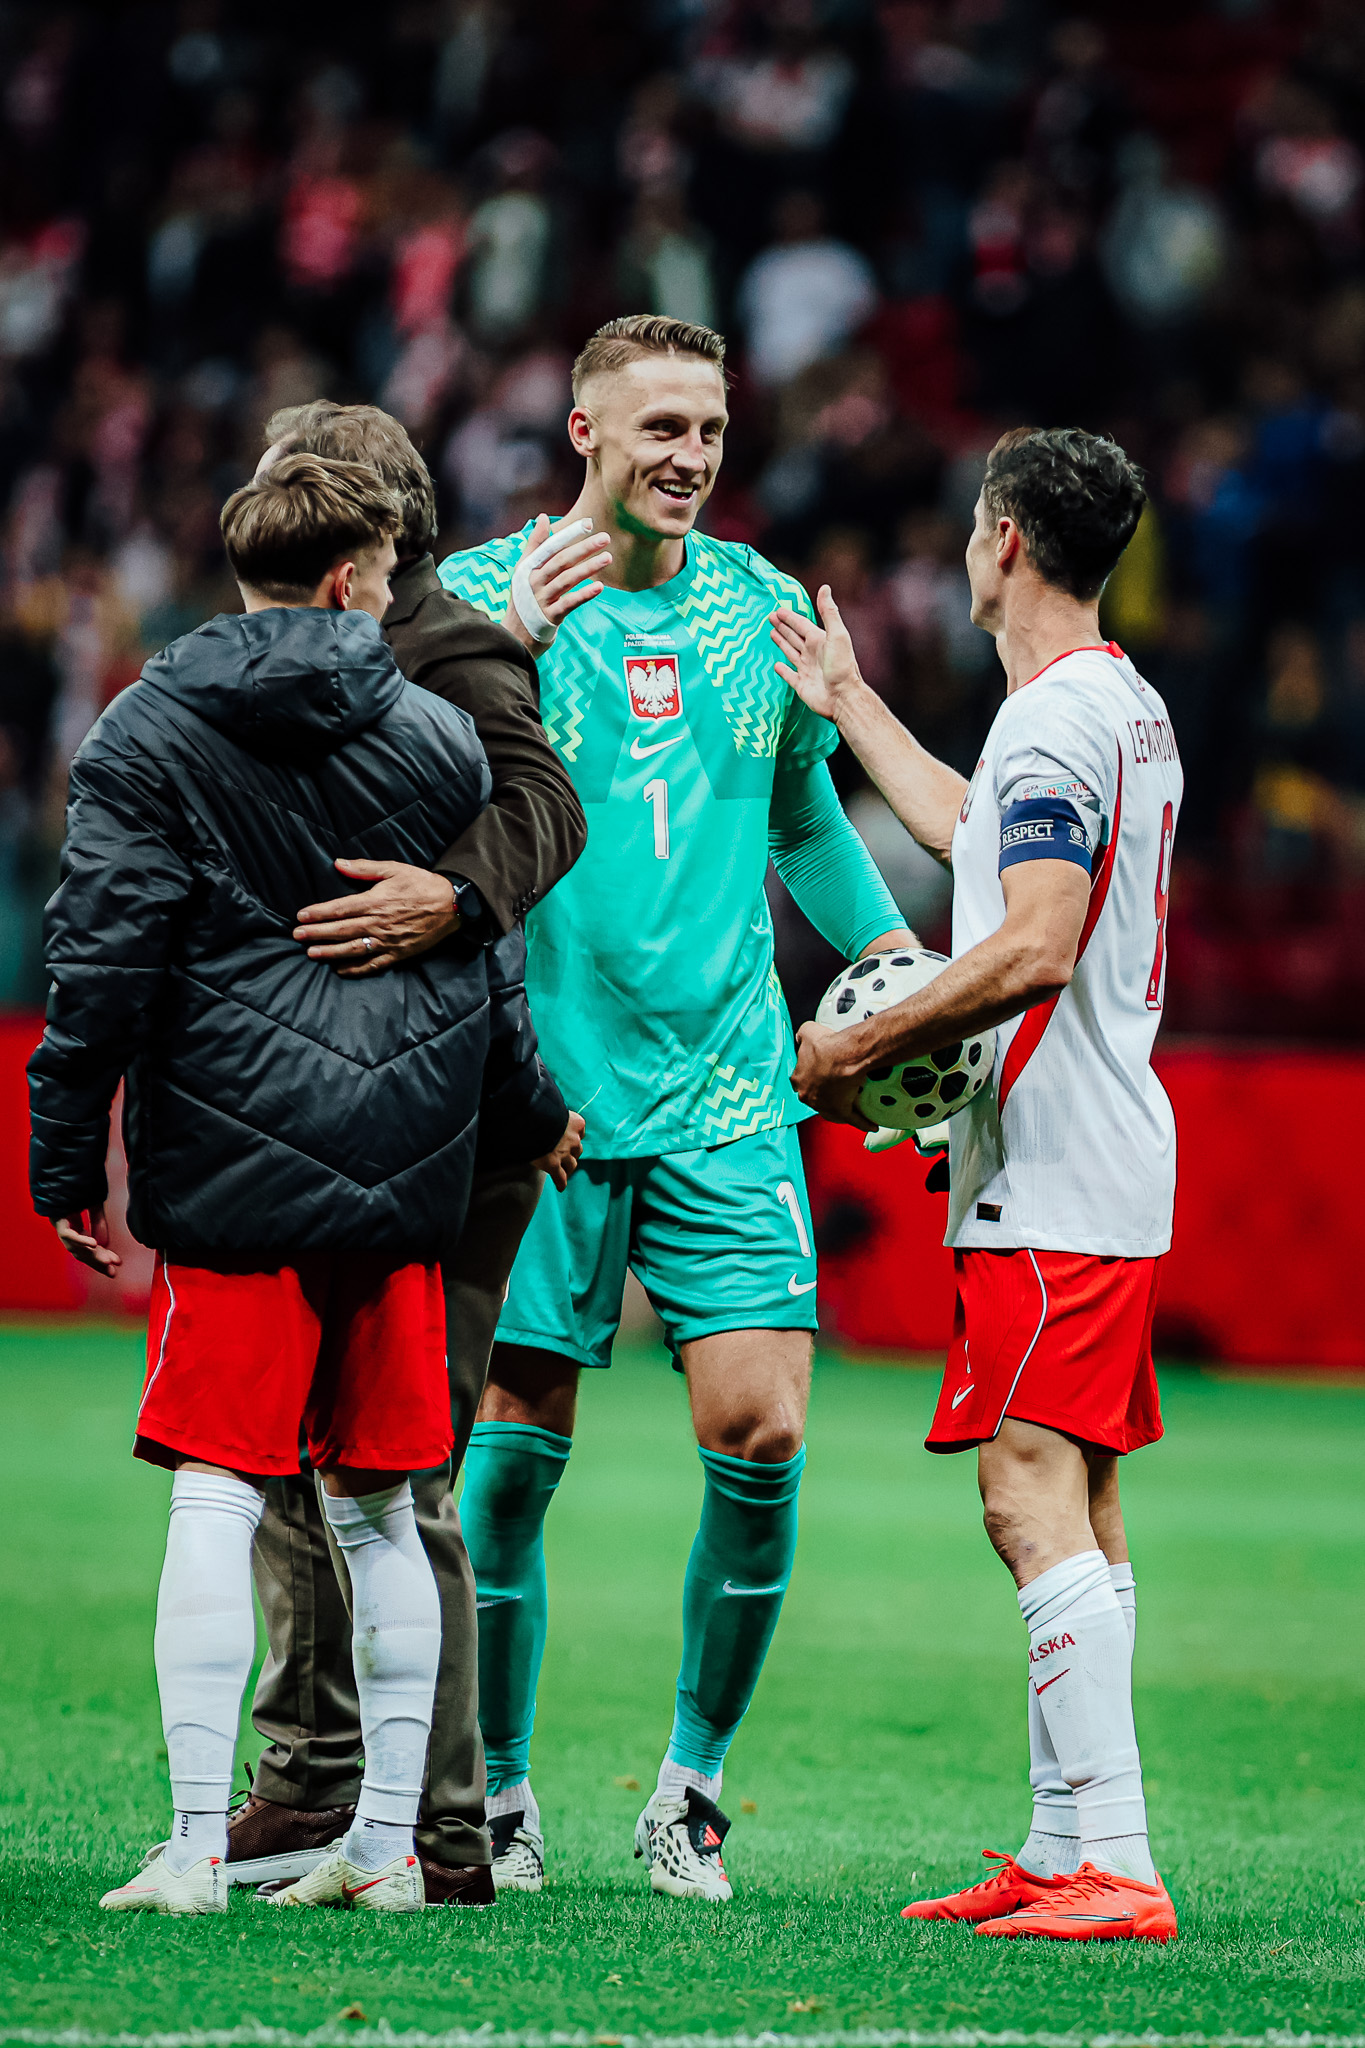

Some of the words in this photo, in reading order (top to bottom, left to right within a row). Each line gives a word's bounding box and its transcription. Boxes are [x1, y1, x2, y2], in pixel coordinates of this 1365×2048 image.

[643, 778, 670, 860] 1
[1002, 823, 1054, 847] RESPECT
[775, 1181, 812, 1258] 1
